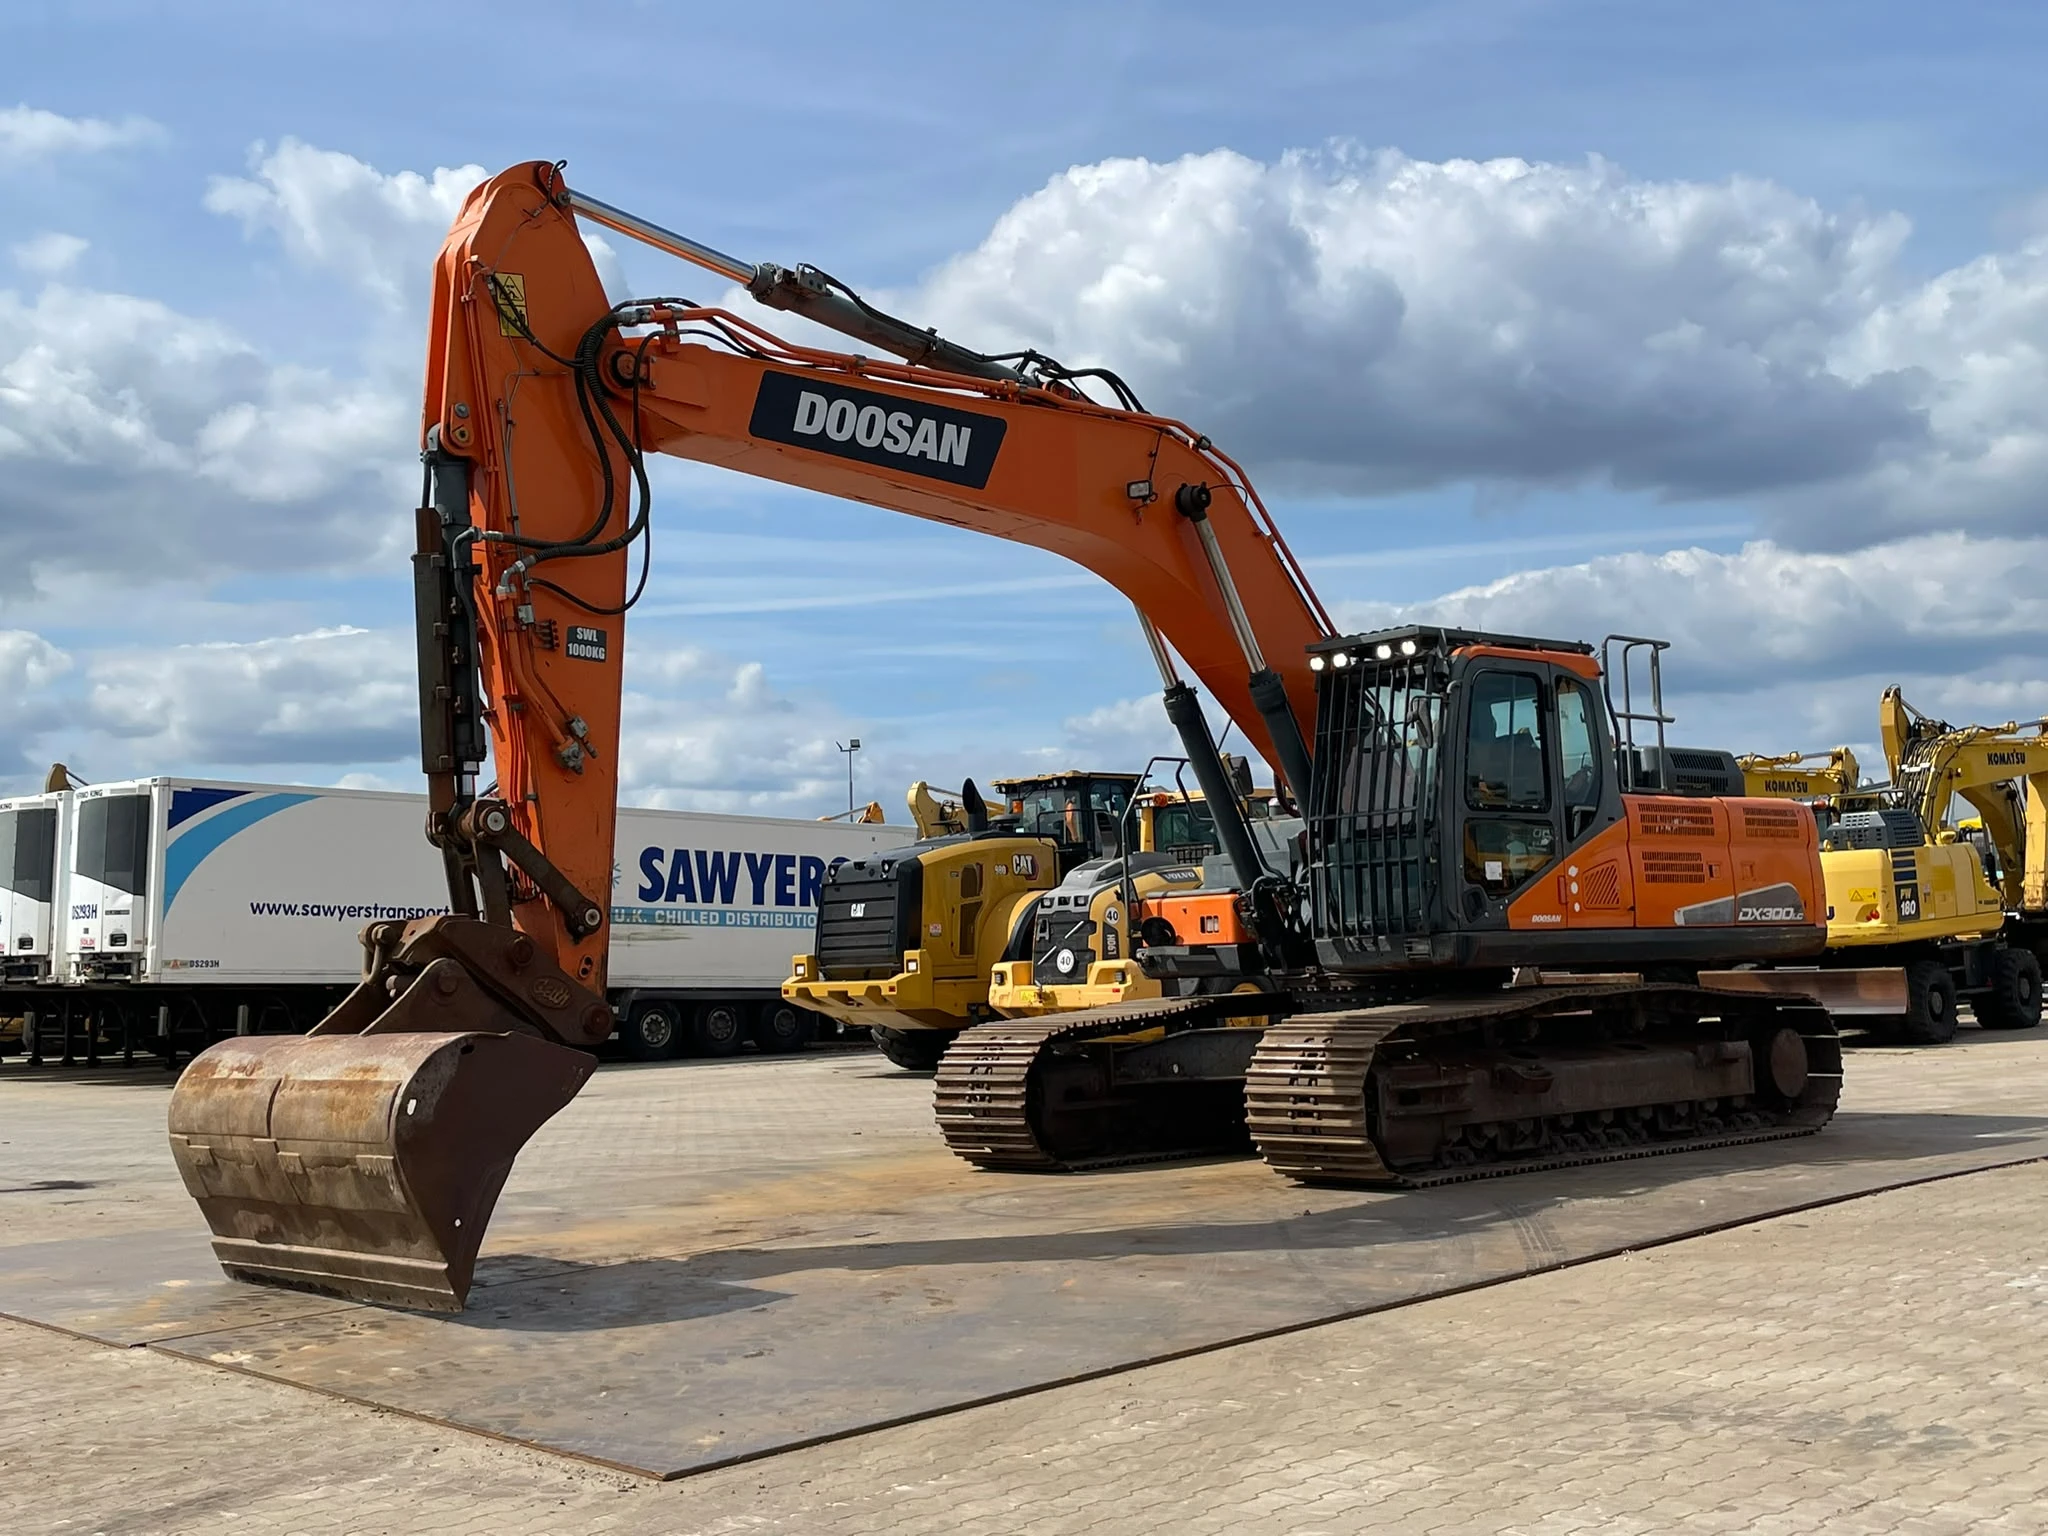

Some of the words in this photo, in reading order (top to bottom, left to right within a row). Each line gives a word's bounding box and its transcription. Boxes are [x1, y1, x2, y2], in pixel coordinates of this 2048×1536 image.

[793, 390, 972, 467] DOOSAN
[576, 627, 598, 642] SWL
[568, 642, 606, 660] 1000KG
[1987, 748, 2026, 766] KOMATSU
[1764, 777, 1808, 793] KOMATSU
[1012, 854, 1033, 875] CAT
[638, 846, 850, 907] SAWYER
[1163, 871, 1196, 880] VOLVO
[850, 903, 866, 918] CAT
[1106, 910, 1119, 921] 40
[1900, 899, 1917, 917] 180
[614, 908, 648, 923] U.K.
[654, 909, 720, 925] CHILLED
[726, 912, 817, 928] DISTRIBUTIO
[1531, 914, 1562, 923] DOOSAN
[189, 959, 220, 968] DS293H
[1060, 956, 1071, 966] 40
